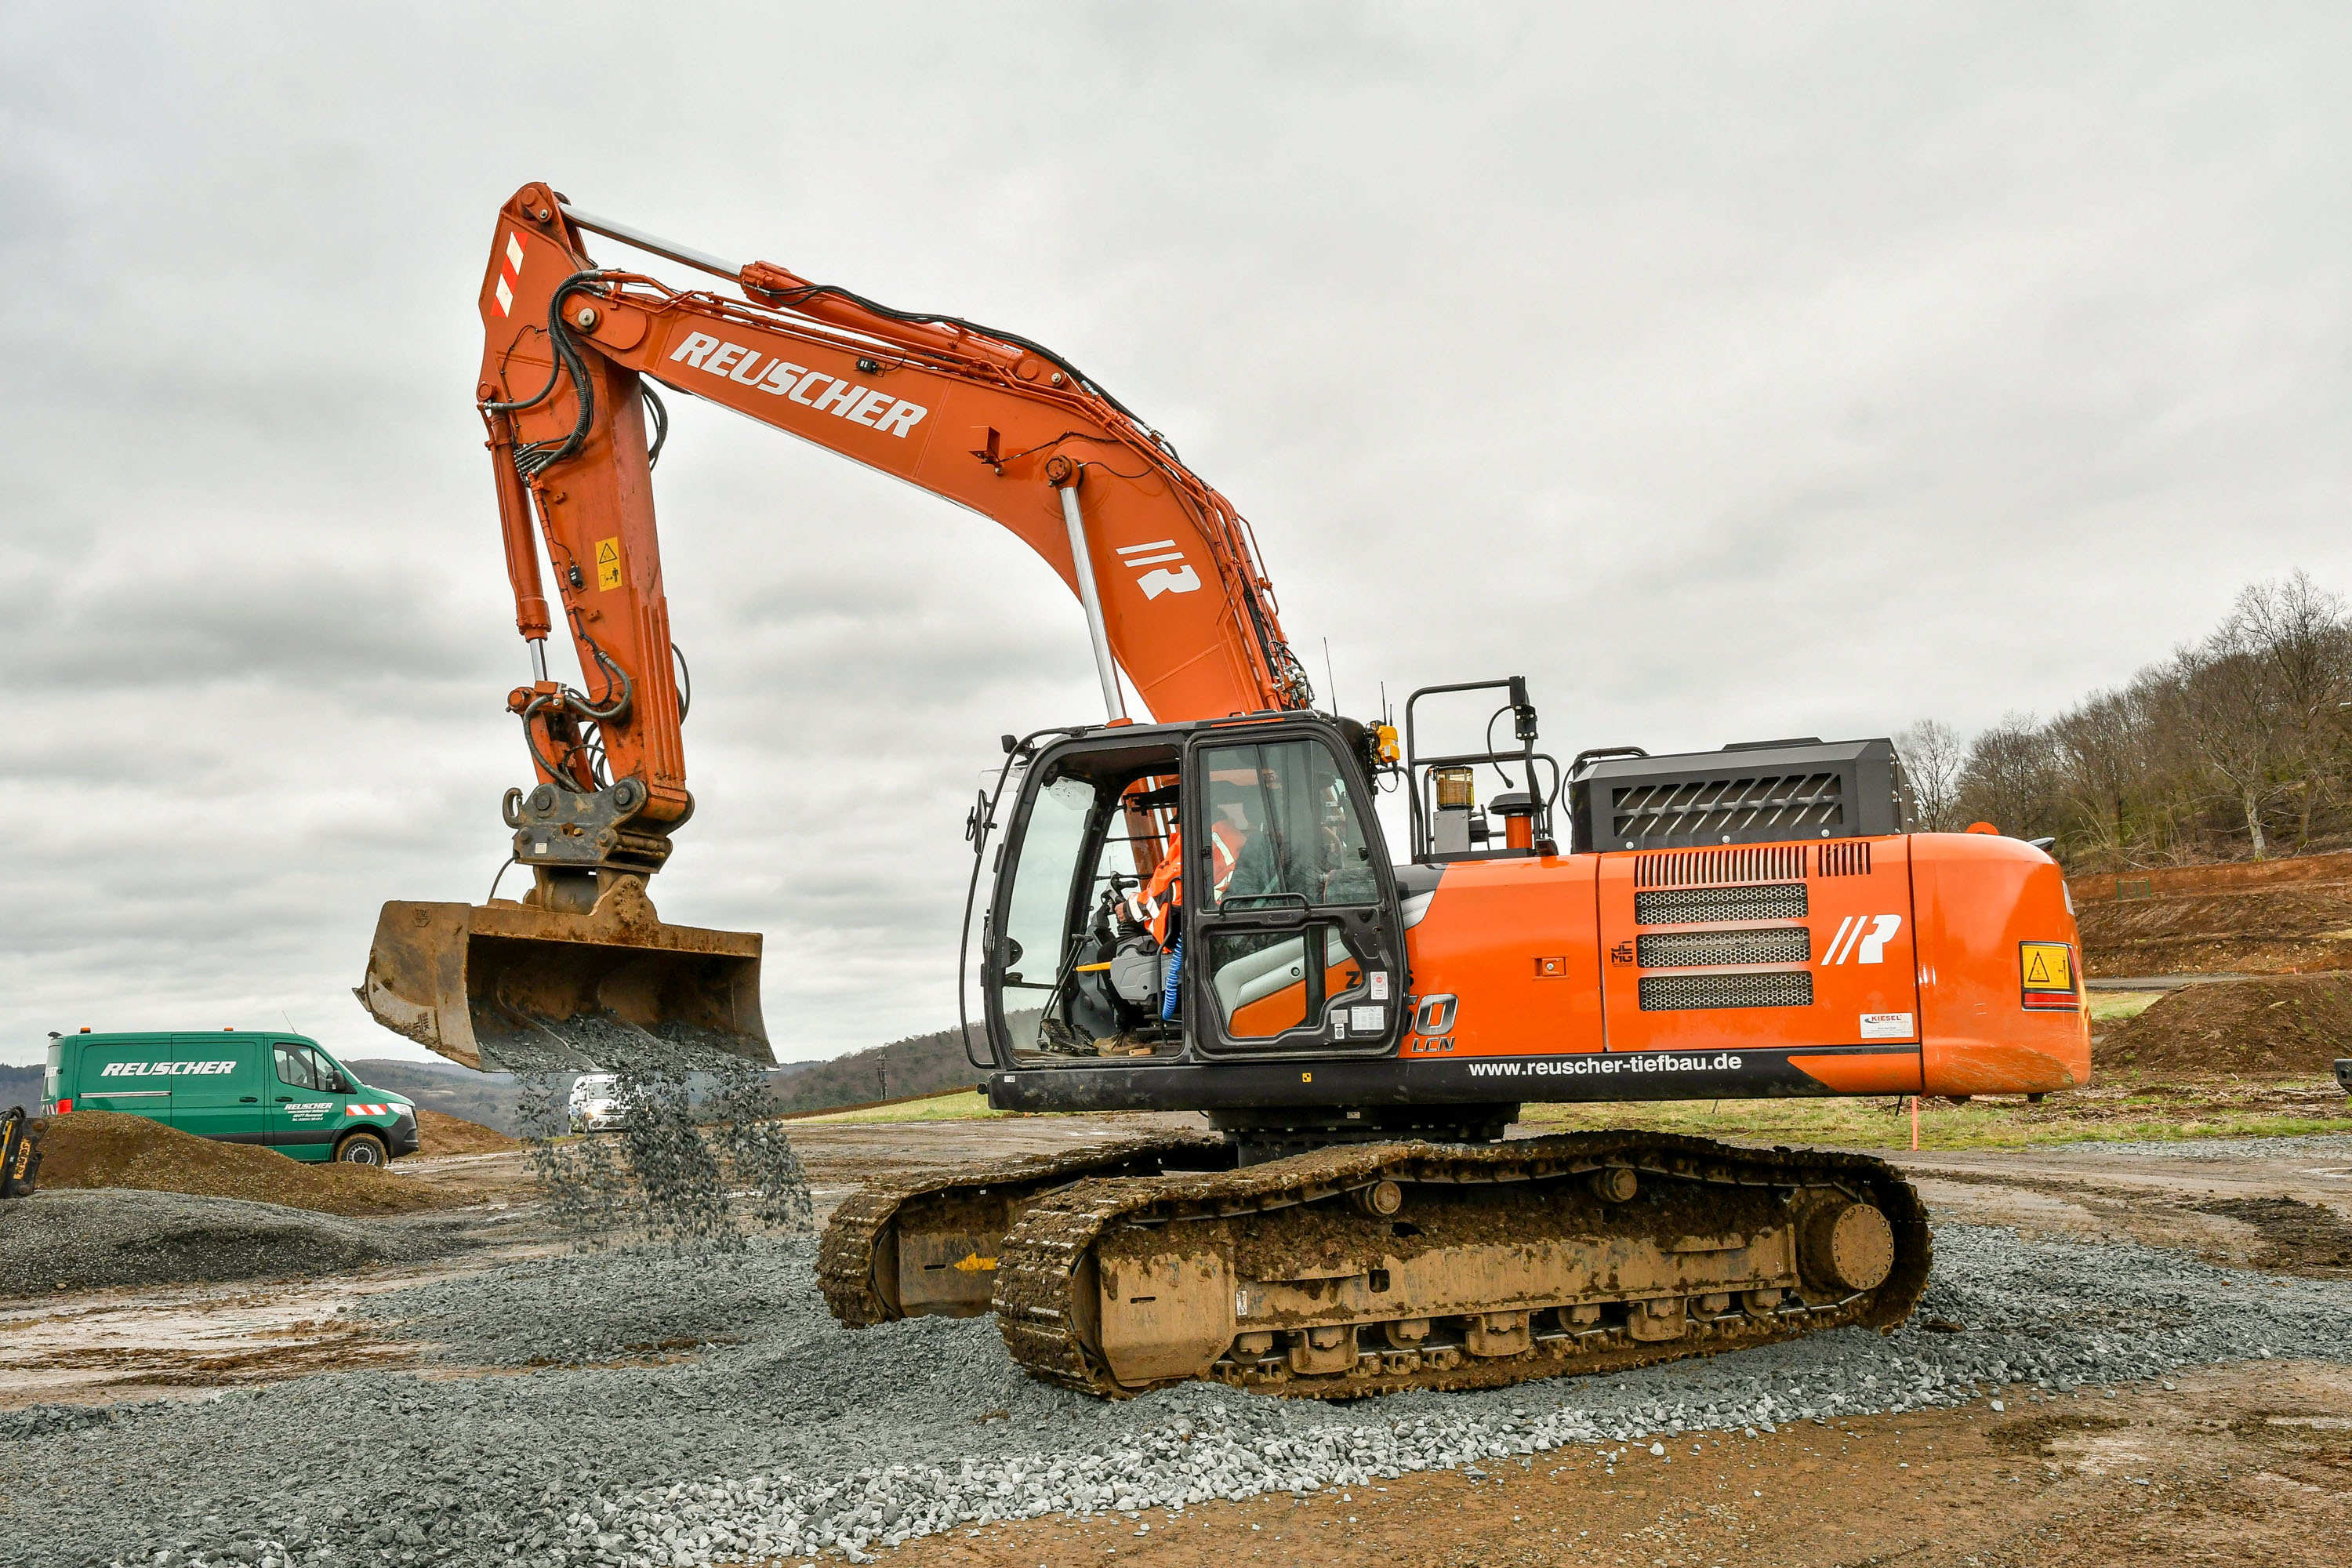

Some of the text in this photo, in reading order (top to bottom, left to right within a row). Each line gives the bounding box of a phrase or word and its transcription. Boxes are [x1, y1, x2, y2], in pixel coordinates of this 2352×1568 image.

[669, 331, 927, 438] REUSCHER
[1411, 1036, 1455, 1052] LCN
[100, 1061, 237, 1076] REUSCHER
[1468, 1053, 1742, 1076] www.reuscher-tiefbau.de
